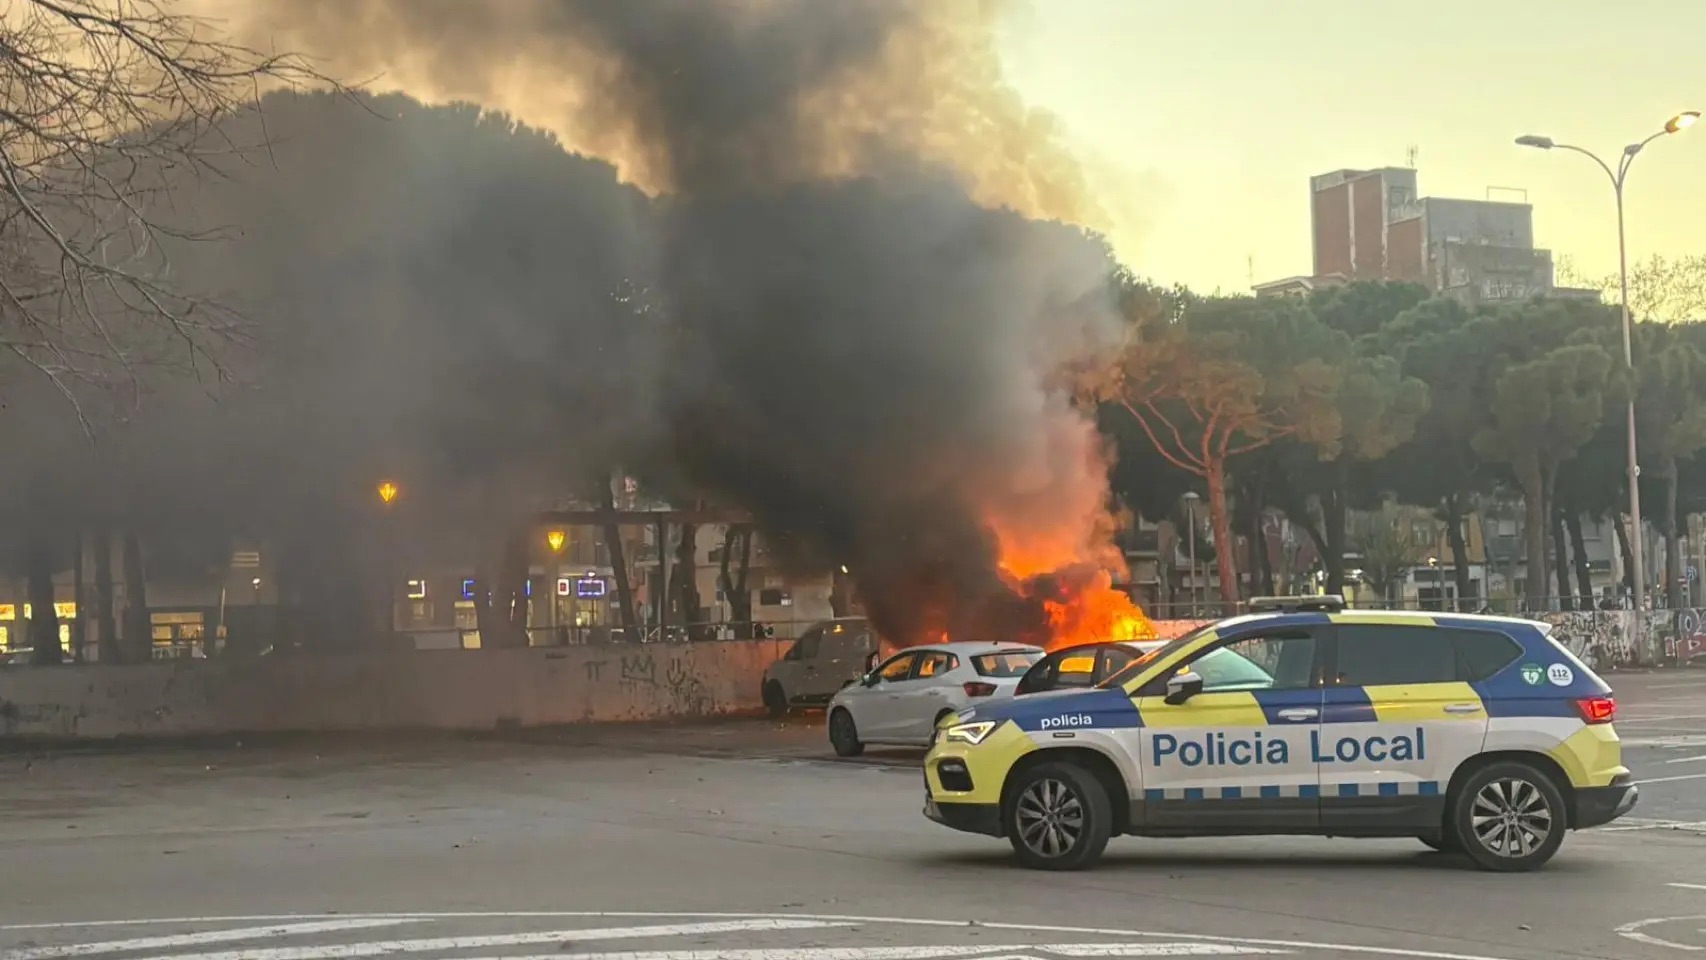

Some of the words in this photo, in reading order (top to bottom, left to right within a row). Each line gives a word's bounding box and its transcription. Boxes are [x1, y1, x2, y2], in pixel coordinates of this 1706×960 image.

[1551, 668, 1568, 678] 112
[1041, 713, 1093, 730] policia
[1152, 731, 1289, 767] Policia
[1310, 727, 1425, 763] Local
